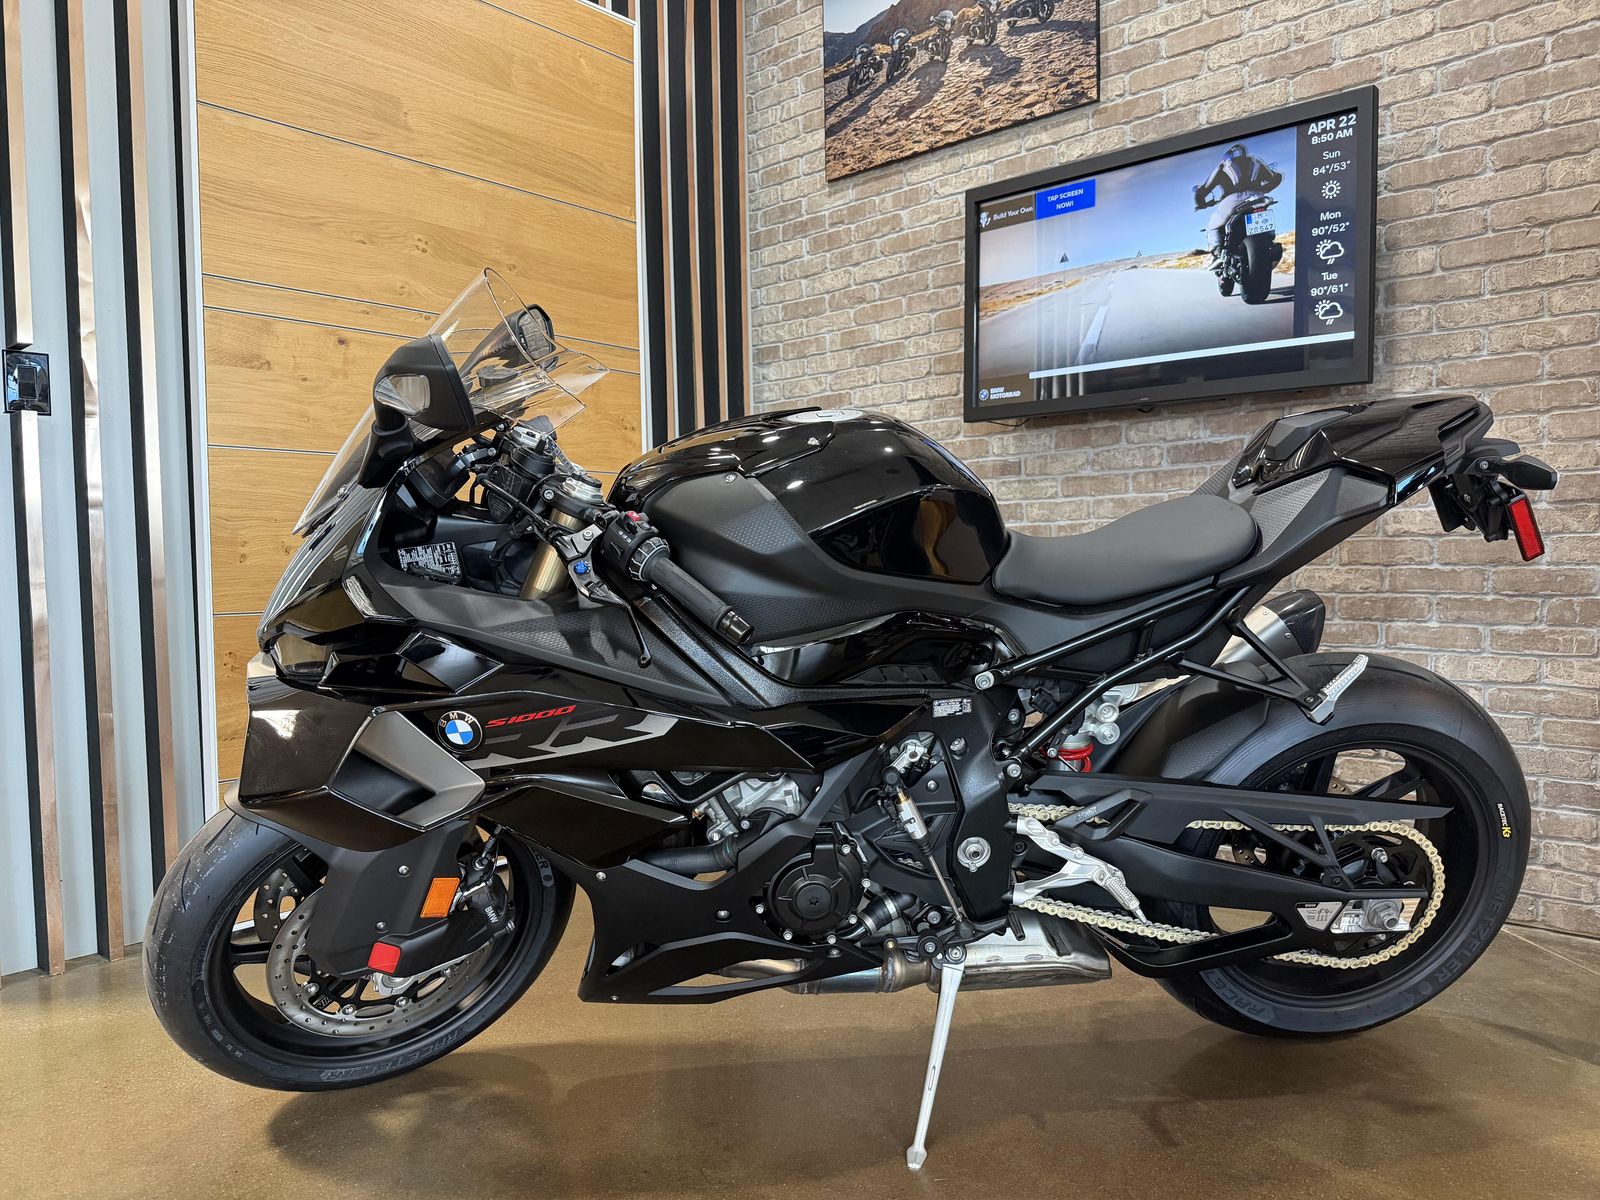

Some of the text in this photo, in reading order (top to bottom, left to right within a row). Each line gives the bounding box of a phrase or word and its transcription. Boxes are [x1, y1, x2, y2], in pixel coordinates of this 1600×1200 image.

[1307, 113, 1358, 135] APR 22
[1311, 128, 1353, 145] 8:50 AM
[1322, 150, 1341, 160] Sun
[1047, 188, 1084, 203] TAP SCREEN
[1056, 201, 1074, 210] NOW!
[993, 206, 1034, 221] Build Your Own
[1320, 210, 1342, 221] Mon
[1321, 271, 1338, 281] Tue
[990, 390, 1021, 400] MOTORRAD
[438, 711, 474, 729] BMW
[484, 704, 577, 728] S1000
[1501, 826, 1512, 838] K3
[485, 905, 499, 923] BMW
